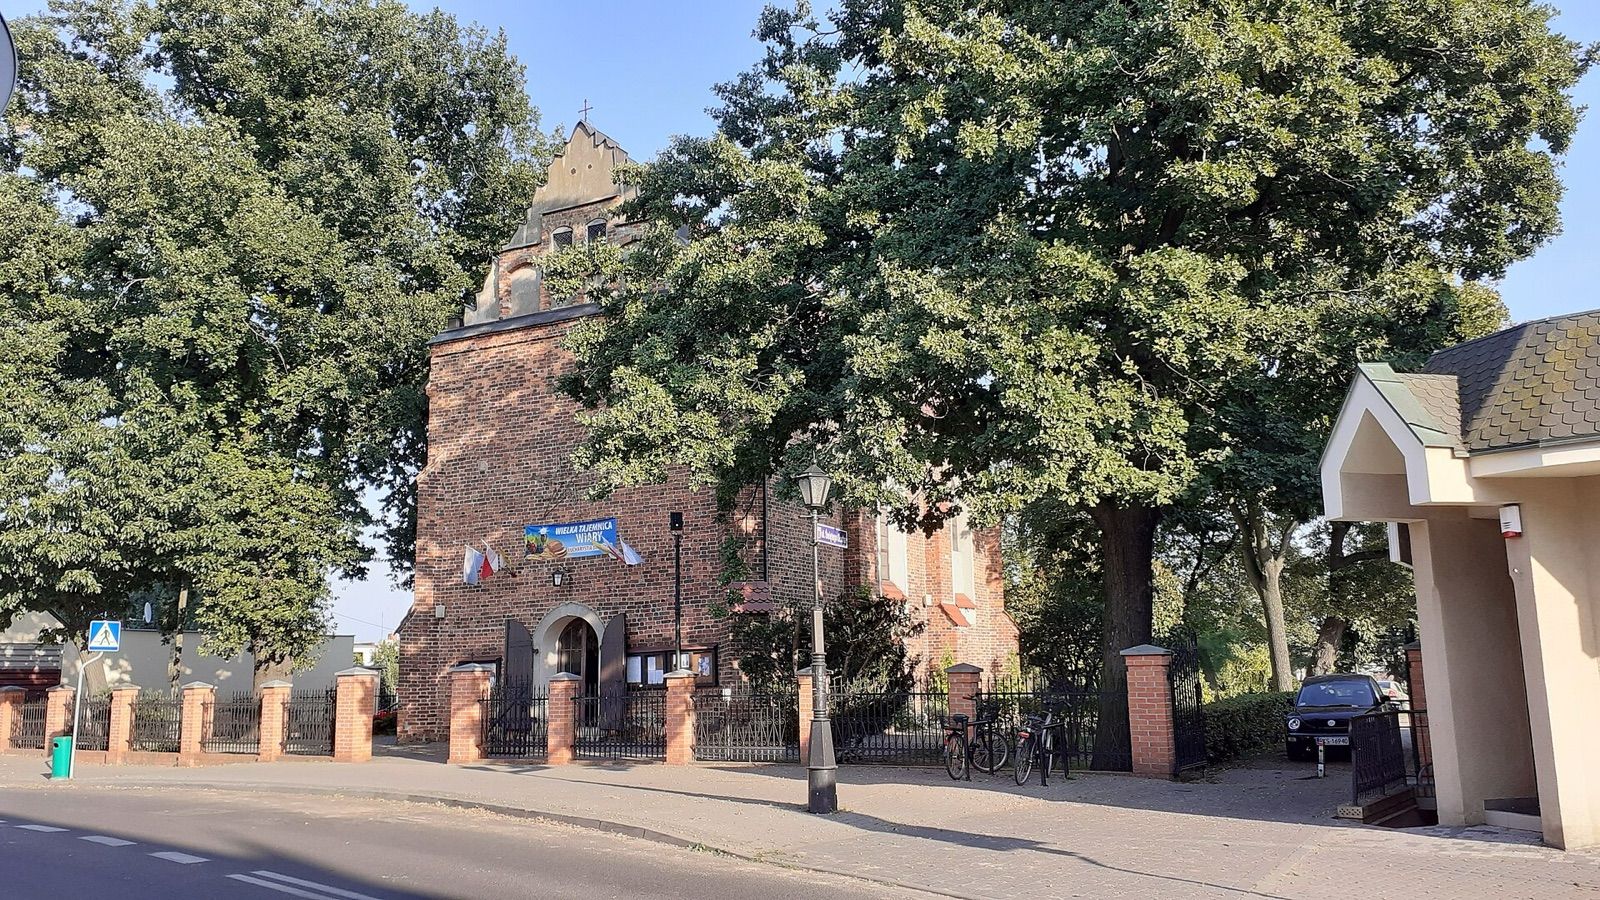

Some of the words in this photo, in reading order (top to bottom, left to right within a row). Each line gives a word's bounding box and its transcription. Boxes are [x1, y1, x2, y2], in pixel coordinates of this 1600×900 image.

[555, 526, 578, 535] WIELKA
[579, 521, 613, 533] TAJEMNICA
[576, 531, 603, 543] WIARY
